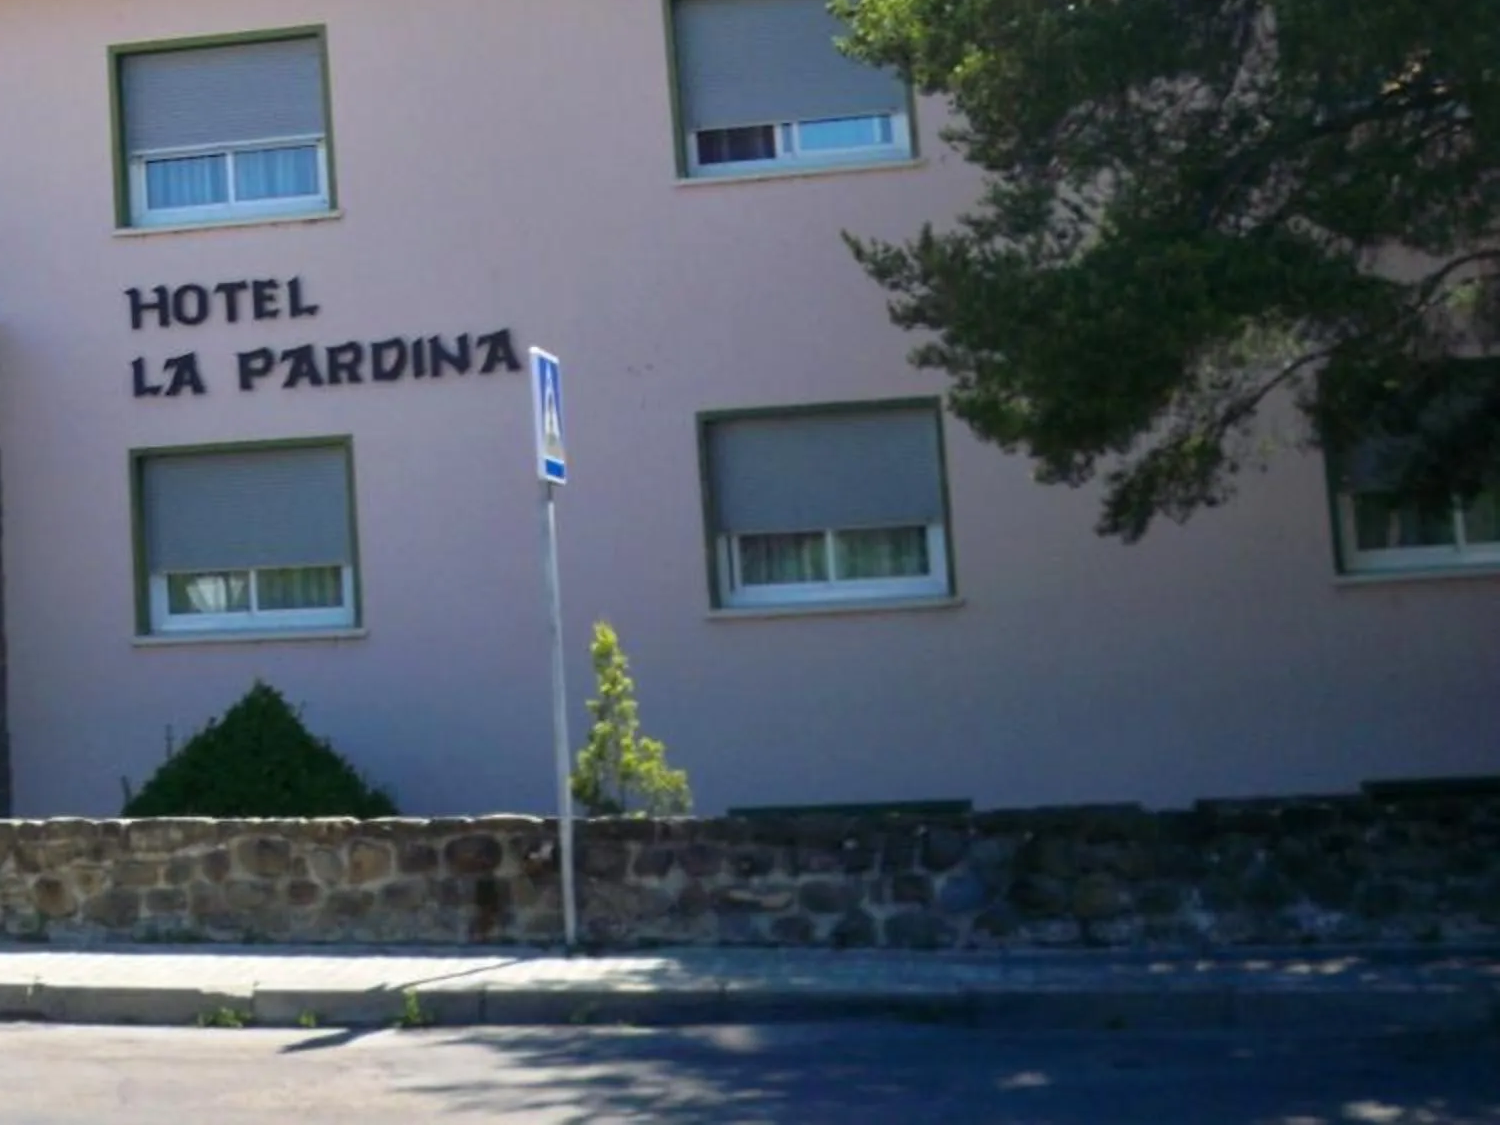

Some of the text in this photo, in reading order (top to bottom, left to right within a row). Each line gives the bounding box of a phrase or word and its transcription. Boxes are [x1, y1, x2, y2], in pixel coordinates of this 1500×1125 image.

[125, 277, 319, 330] HOTEL
[131, 328, 522, 398] LA PARDINA
